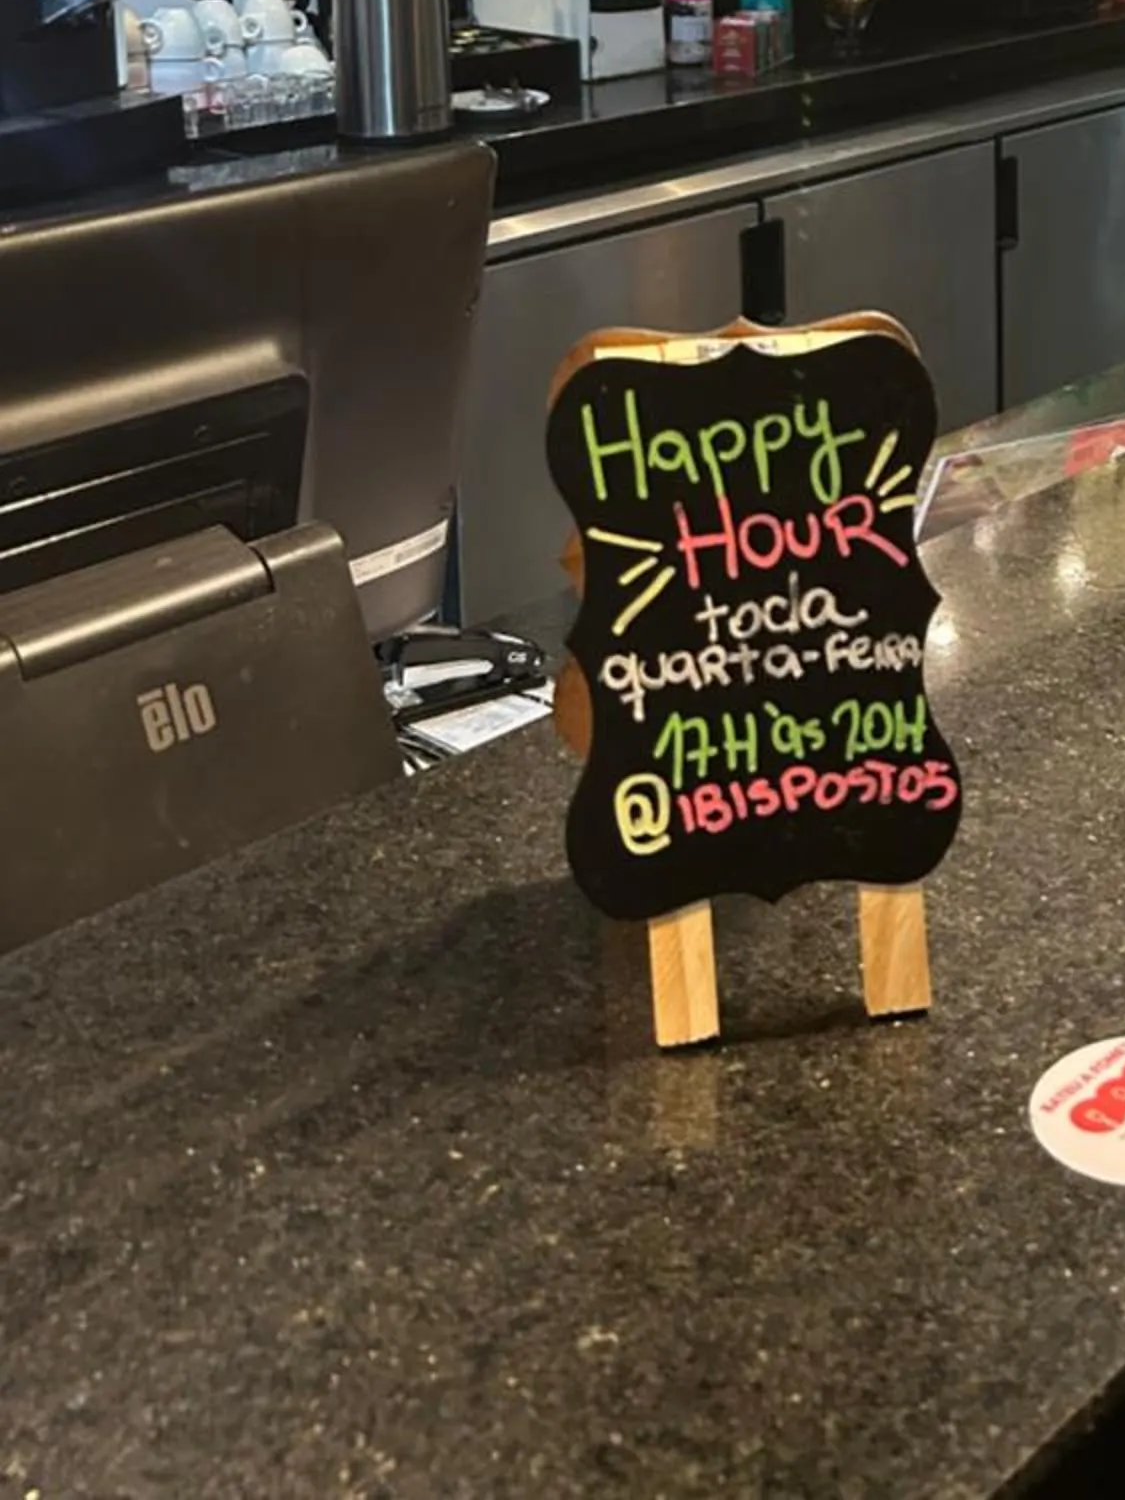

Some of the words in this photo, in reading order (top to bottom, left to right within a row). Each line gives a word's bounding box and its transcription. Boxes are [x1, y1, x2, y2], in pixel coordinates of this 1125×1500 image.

[582, 388, 866, 504] Happy
[694, 570, 869, 642] toda
[831, 693, 928, 762] 20H
